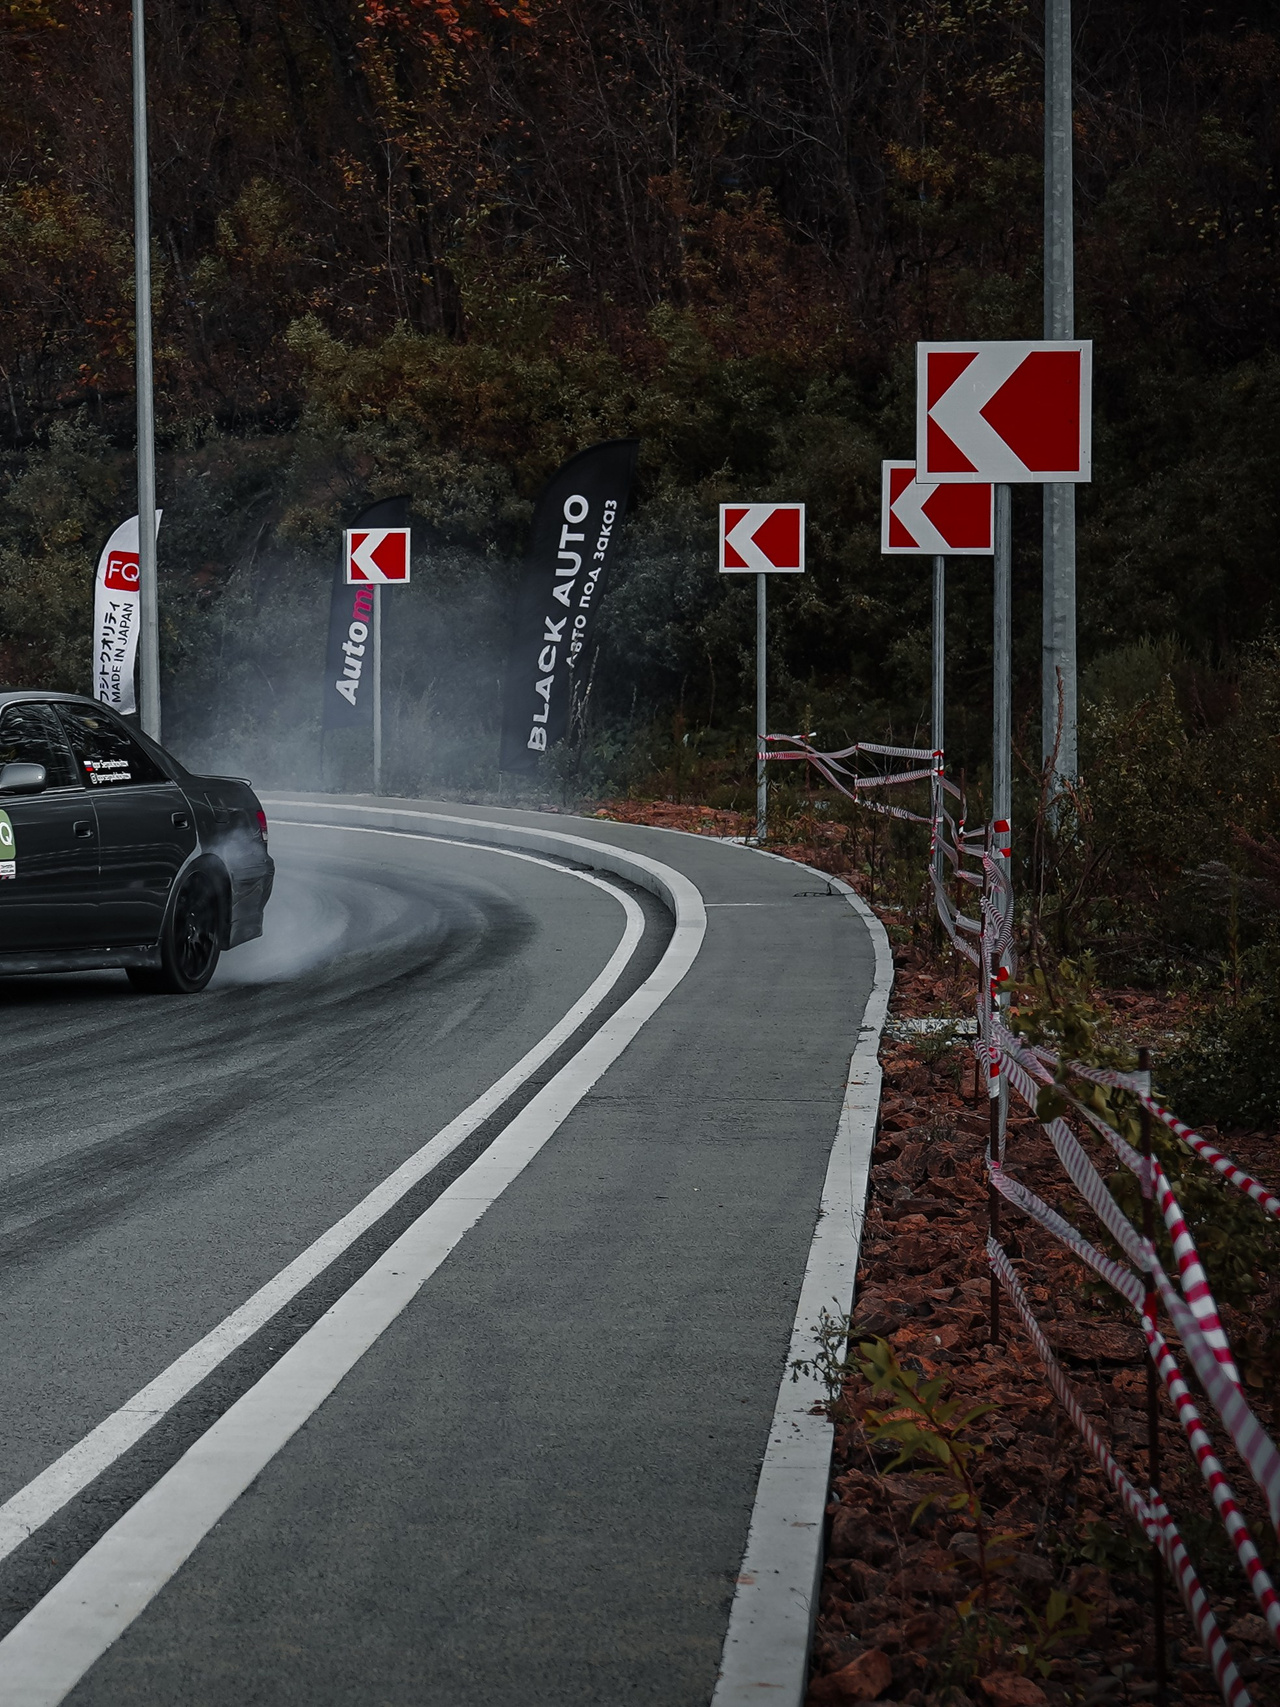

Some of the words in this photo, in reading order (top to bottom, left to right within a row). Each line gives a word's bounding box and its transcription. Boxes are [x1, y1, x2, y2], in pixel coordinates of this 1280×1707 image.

[108, 560, 140, 583] FQ
[117, 603, 134, 646] JAPAN
[527, 616, 568, 752] BLACK
[552, 494, 589, 608] AUTO
[114, 648, 126, 663] IN
[111, 665, 122, 703] MADE
